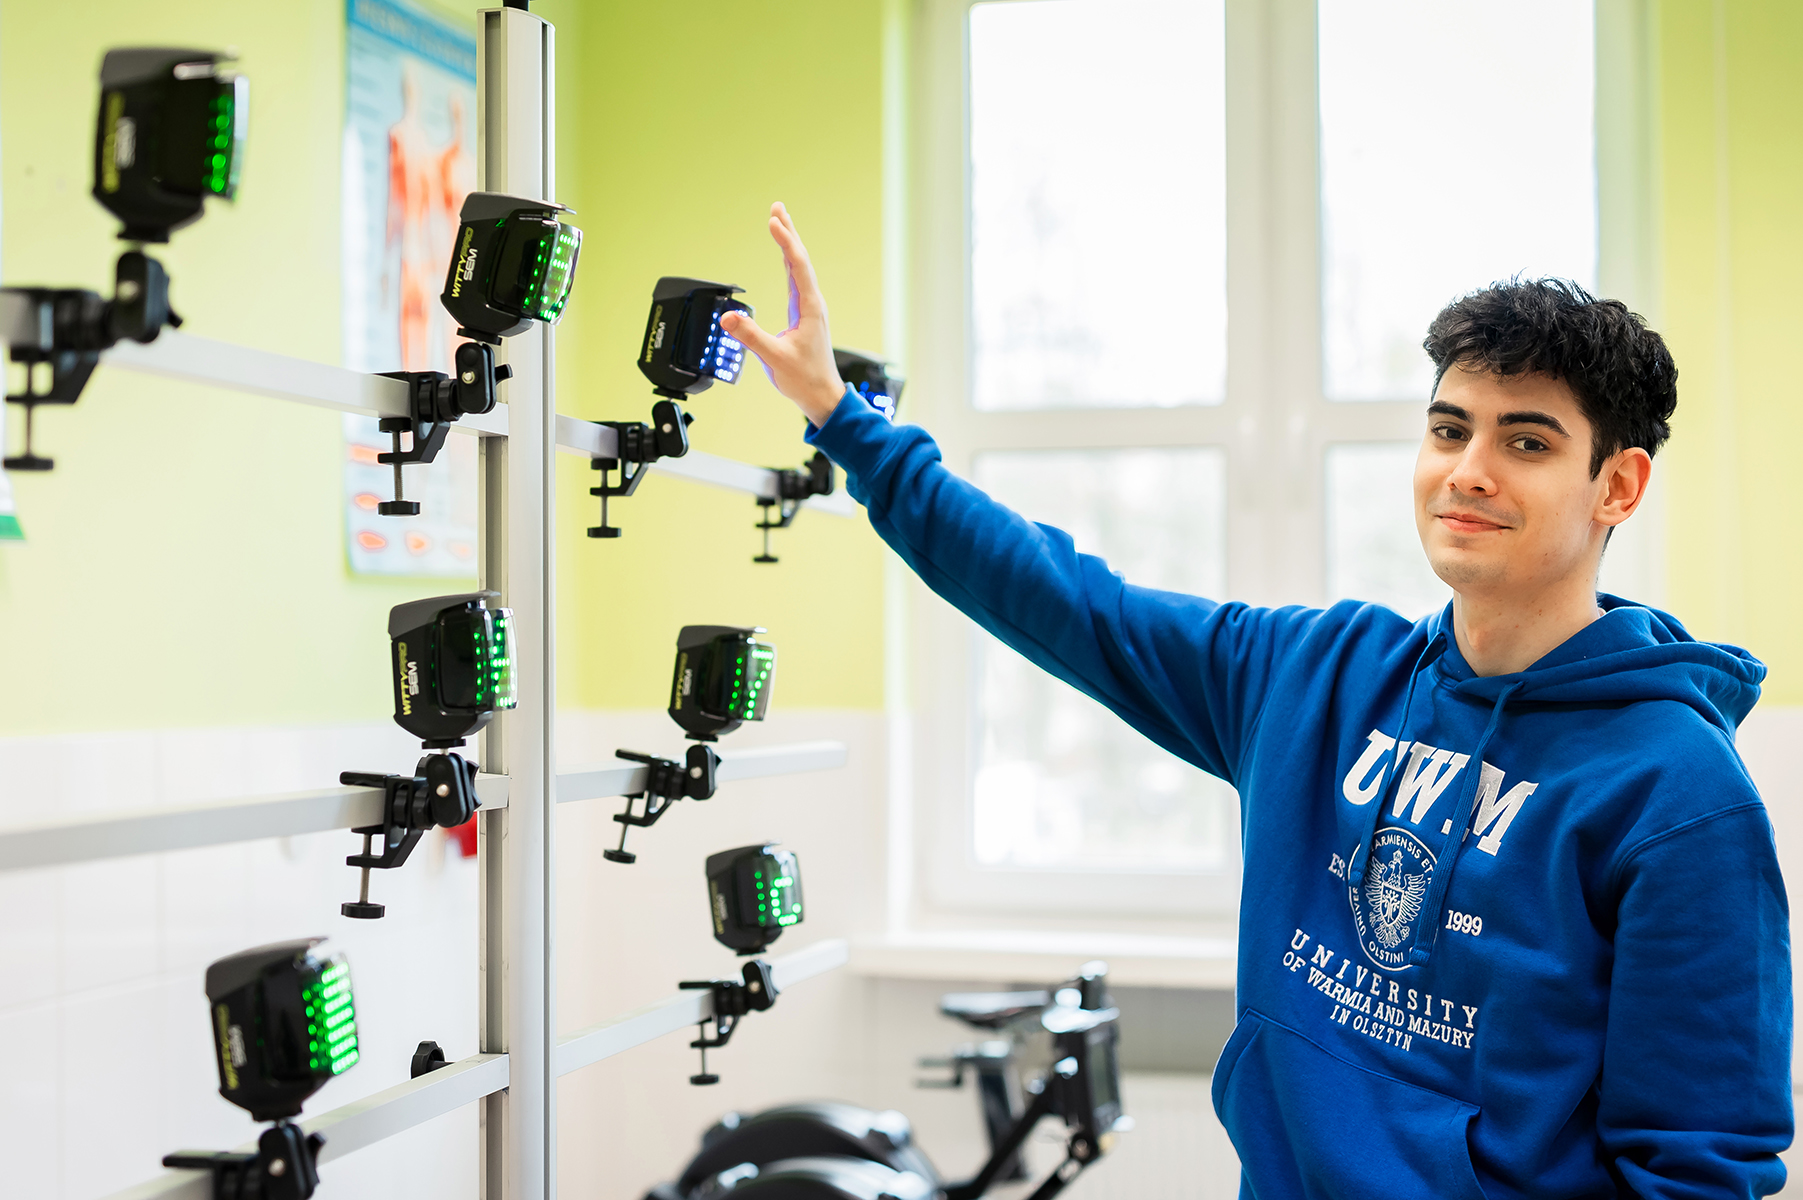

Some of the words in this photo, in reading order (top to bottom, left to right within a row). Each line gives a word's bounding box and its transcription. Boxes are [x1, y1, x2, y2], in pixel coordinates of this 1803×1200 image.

[463, 248, 479, 281] SEM
[1343, 728, 1540, 857] UWM
[1371, 833, 1422, 859] ARMIENSIS
[1445, 909, 1483, 937] 1999
[1369, 941, 1405, 964] OLSTINI
[1290, 928, 1478, 1029] UNIVERSITY
[1282, 951, 1307, 973] OF
[1307, 966, 1371, 1015] WARMIA
[1372, 1001, 1405, 1027] AND
[1407, 1014, 1475, 1049] MAZURY
[1329, 1004, 1352, 1026] IN
[1353, 1015, 1413, 1052] OLSZTYN
